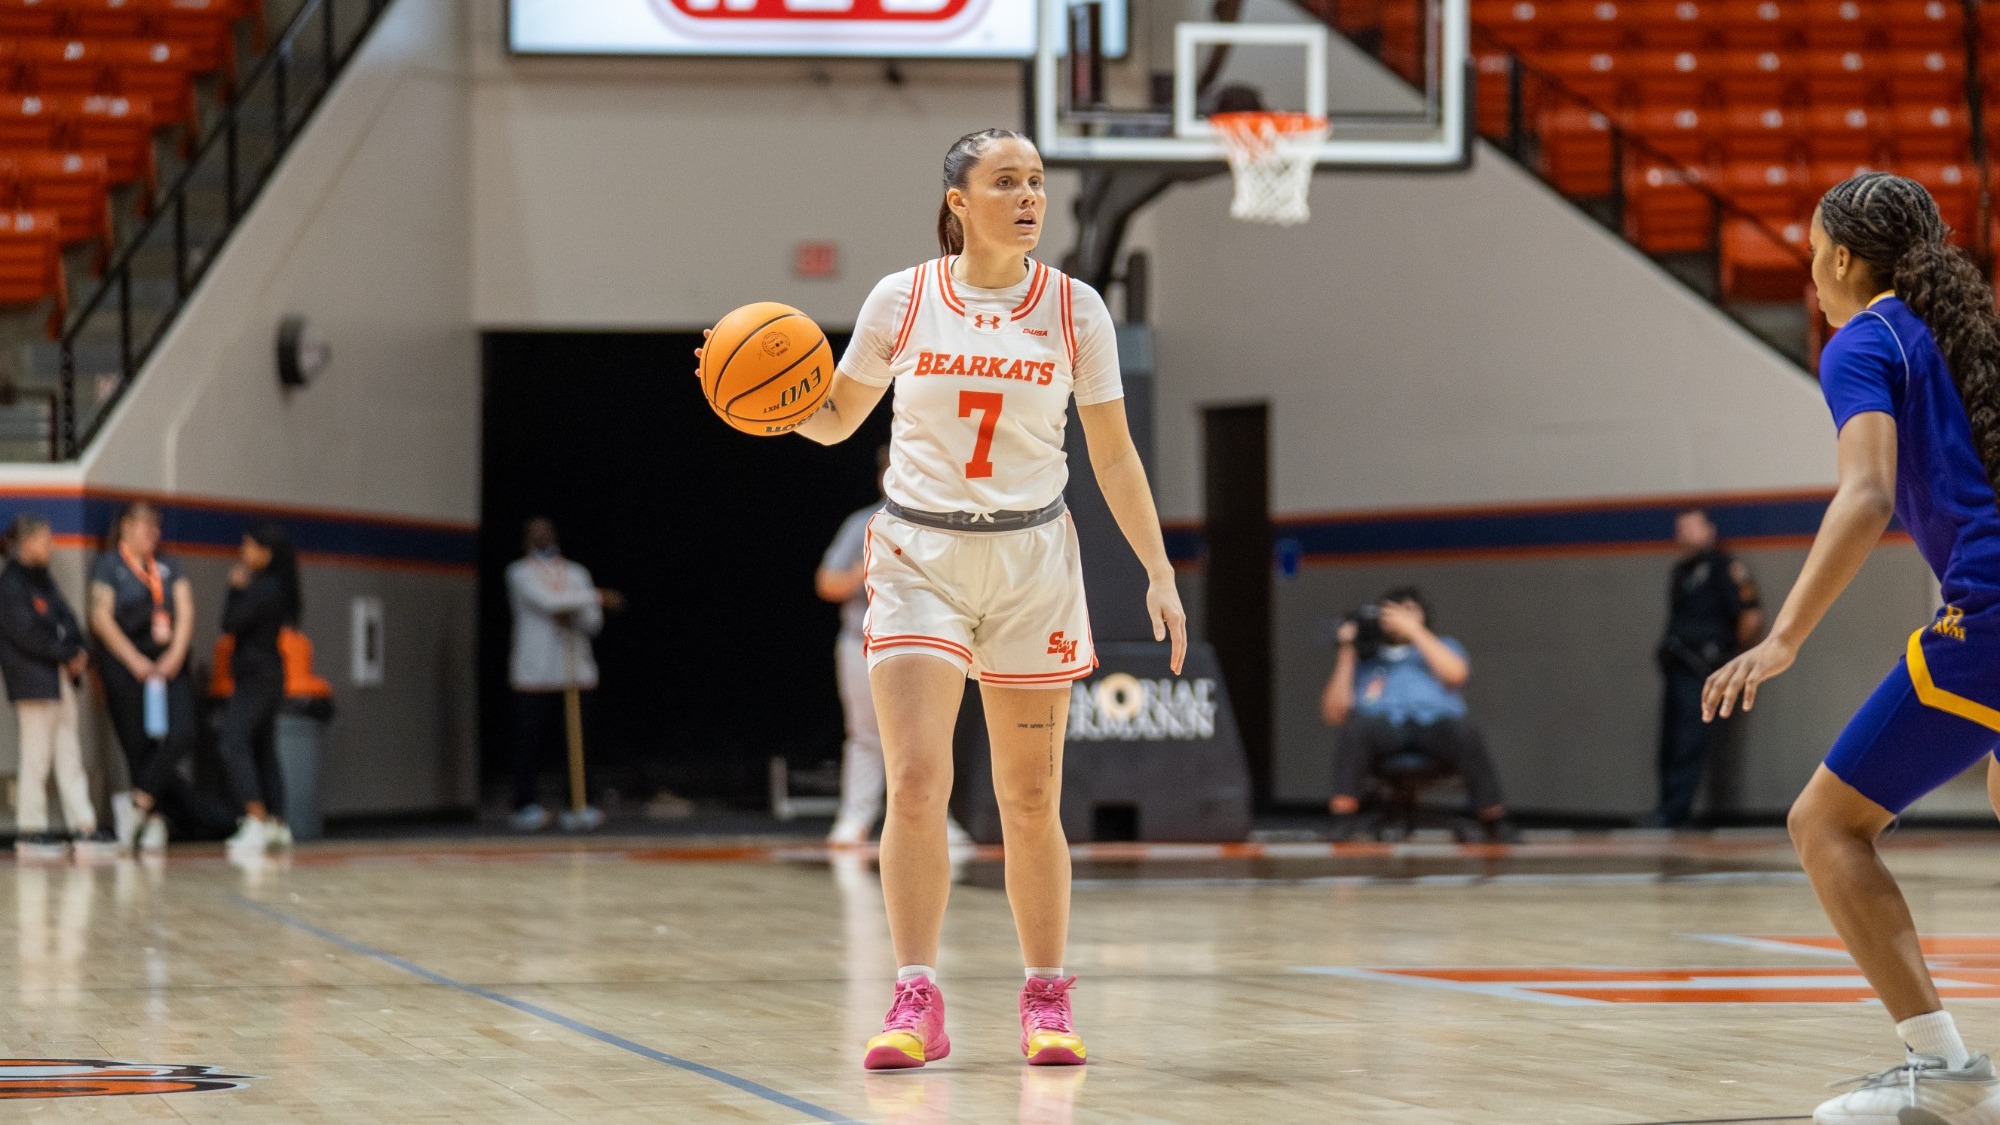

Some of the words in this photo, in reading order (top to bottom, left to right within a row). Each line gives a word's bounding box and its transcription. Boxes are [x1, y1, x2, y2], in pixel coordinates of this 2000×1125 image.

[780, 366, 821, 407] EVO
[914, 352, 1055, 386] BEARKATS
[762, 404, 780, 414] NXT
[958, 390, 1003, 479] 7
